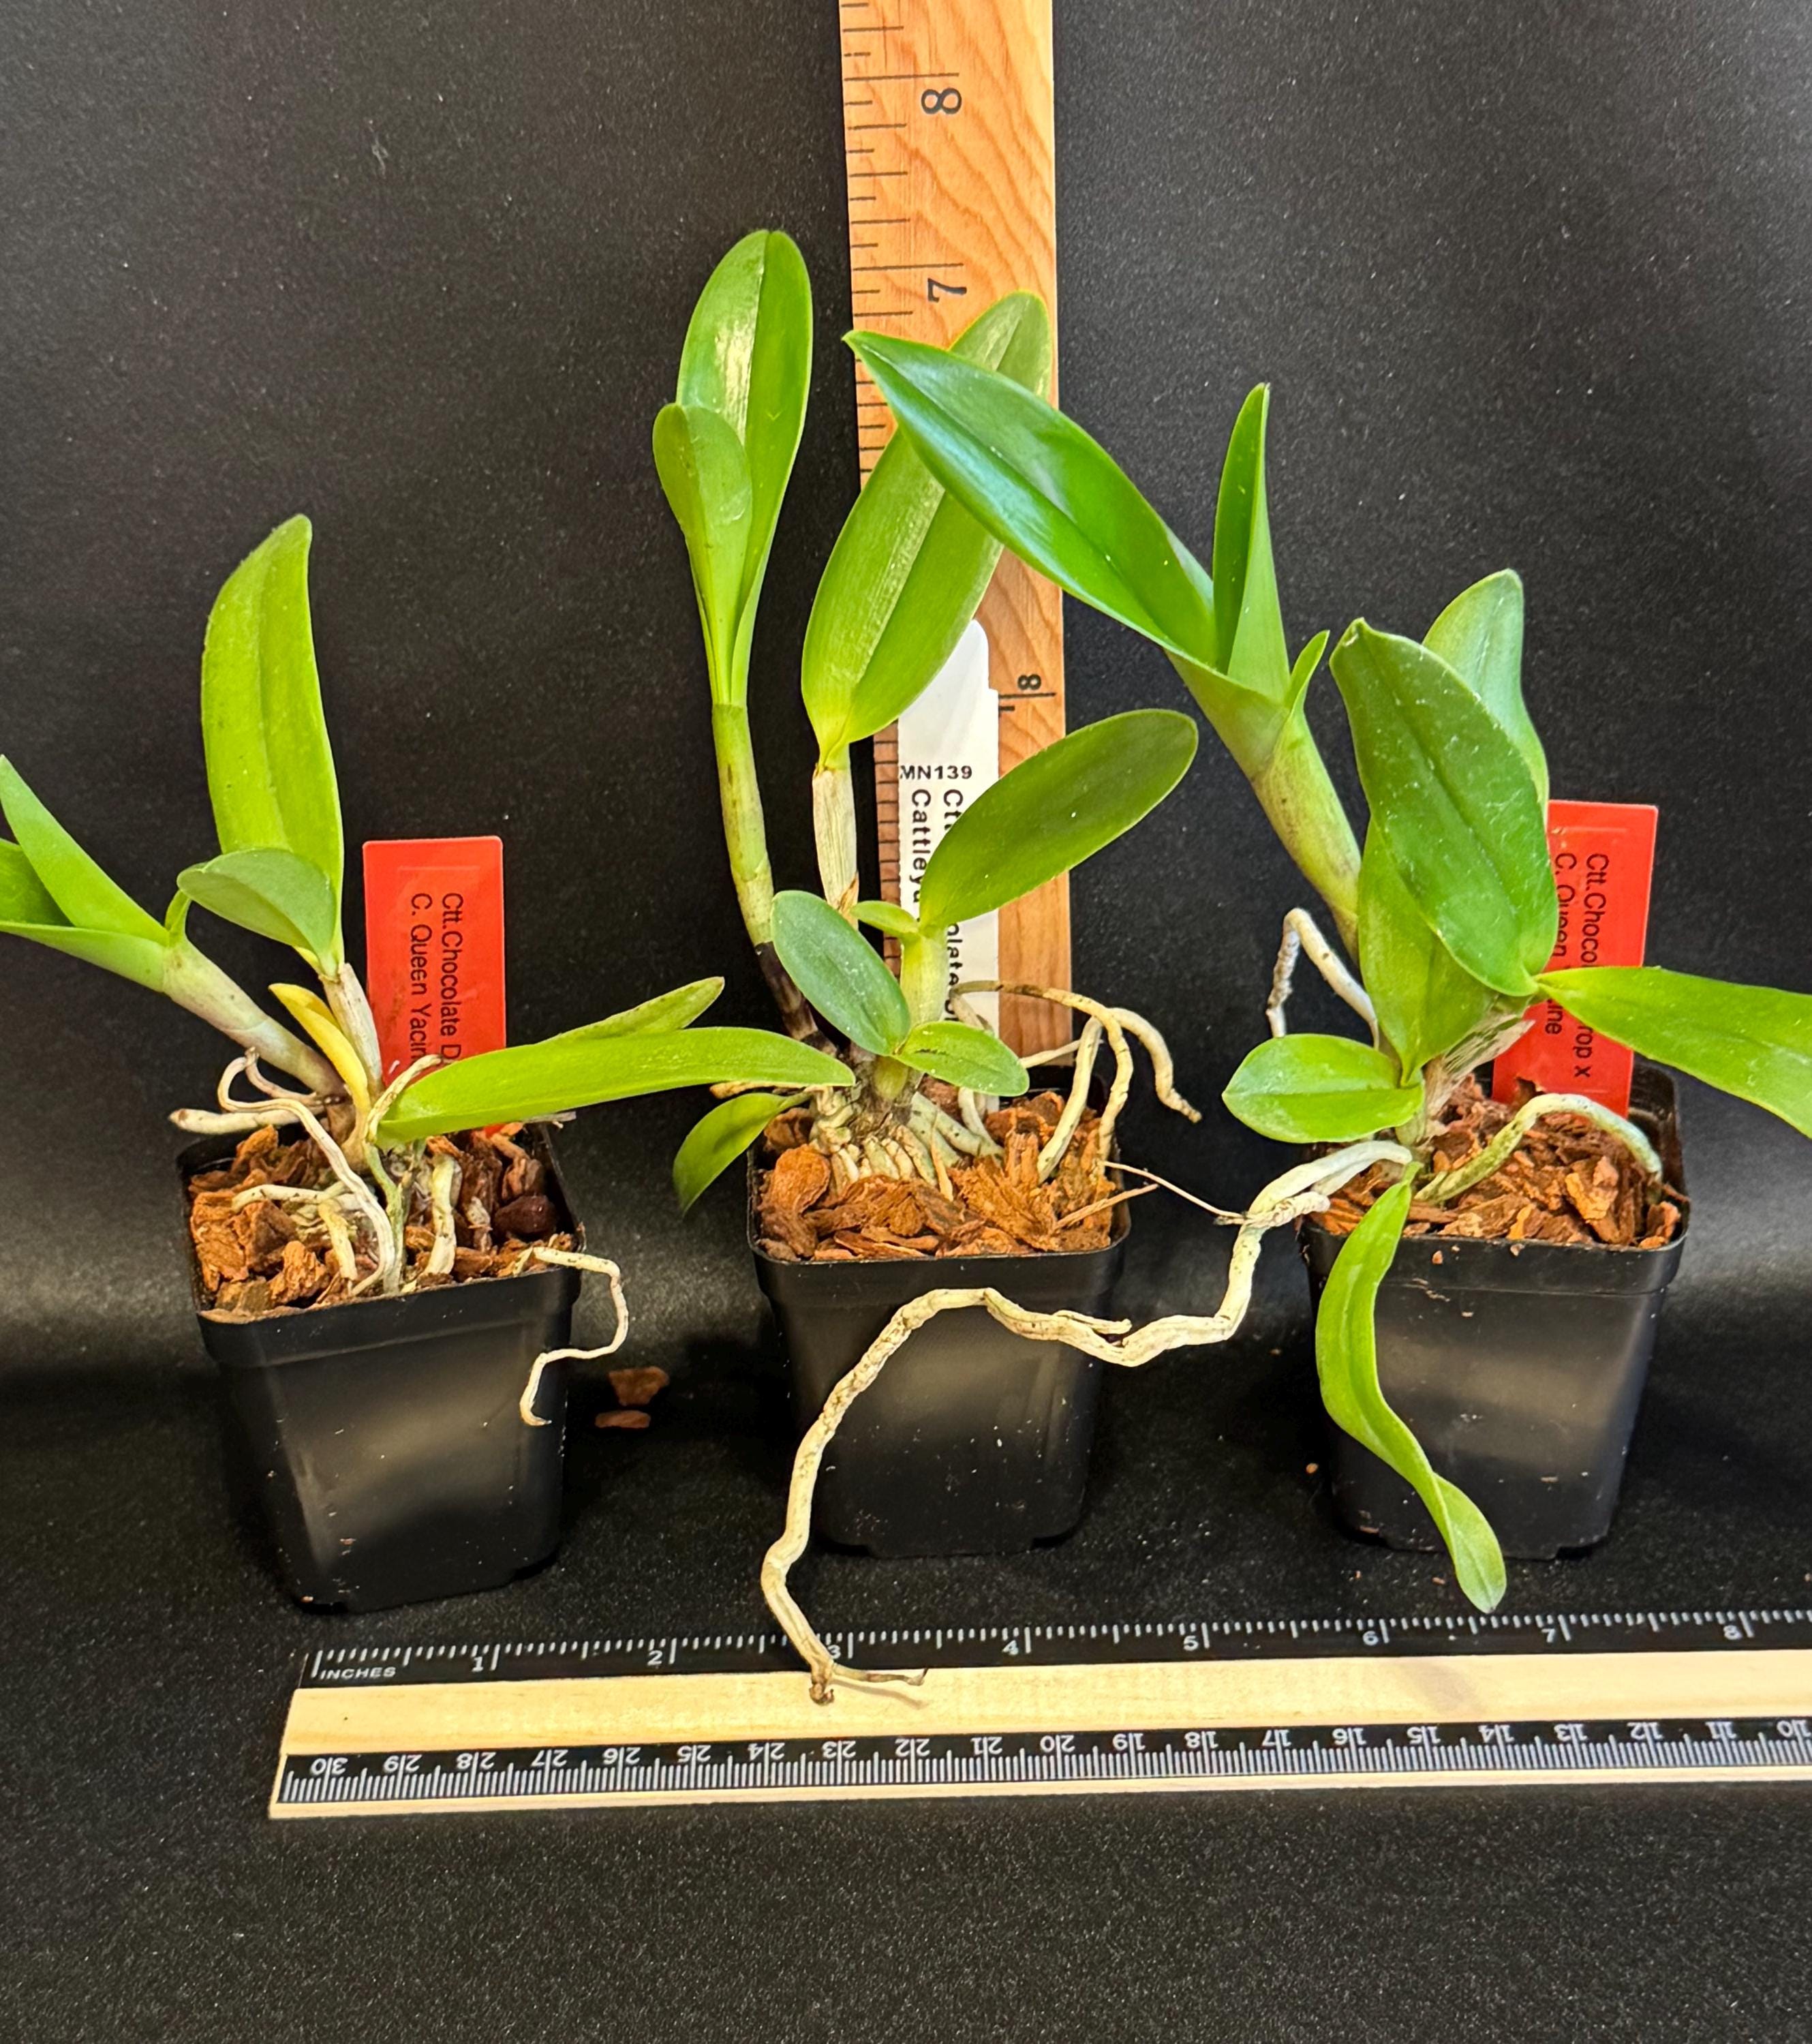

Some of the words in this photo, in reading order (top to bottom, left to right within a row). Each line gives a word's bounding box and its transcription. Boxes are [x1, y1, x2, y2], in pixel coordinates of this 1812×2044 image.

[921, 88, 962, 114] 8
[927, 278, 967, 303] 7
[900, 765, 972, 780] MN139
[411, 893, 433, 916] C.
[410, 924, 433, 995] Queen
[440, 893, 464, 1036] Ctt.Chocolate
[410, 1003, 432, 1059] Yacin
[1573, 1025, 1593, 1058] rop
[472, 1657, 484, 1672] 1
[647, 1650, 664, 1666] 2
[827, 1644, 842, 1660] 3
[1002, 1640, 1019, 1656] 4
[1183, 1635, 1199, 1651] 5
[1362, 1631, 1379, 1646] 6
[1541, 1628, 1556, 1643] 7
[1723, 1625, 1742, 1640] 8
[320, 1666, 396, 1681] INCHES
